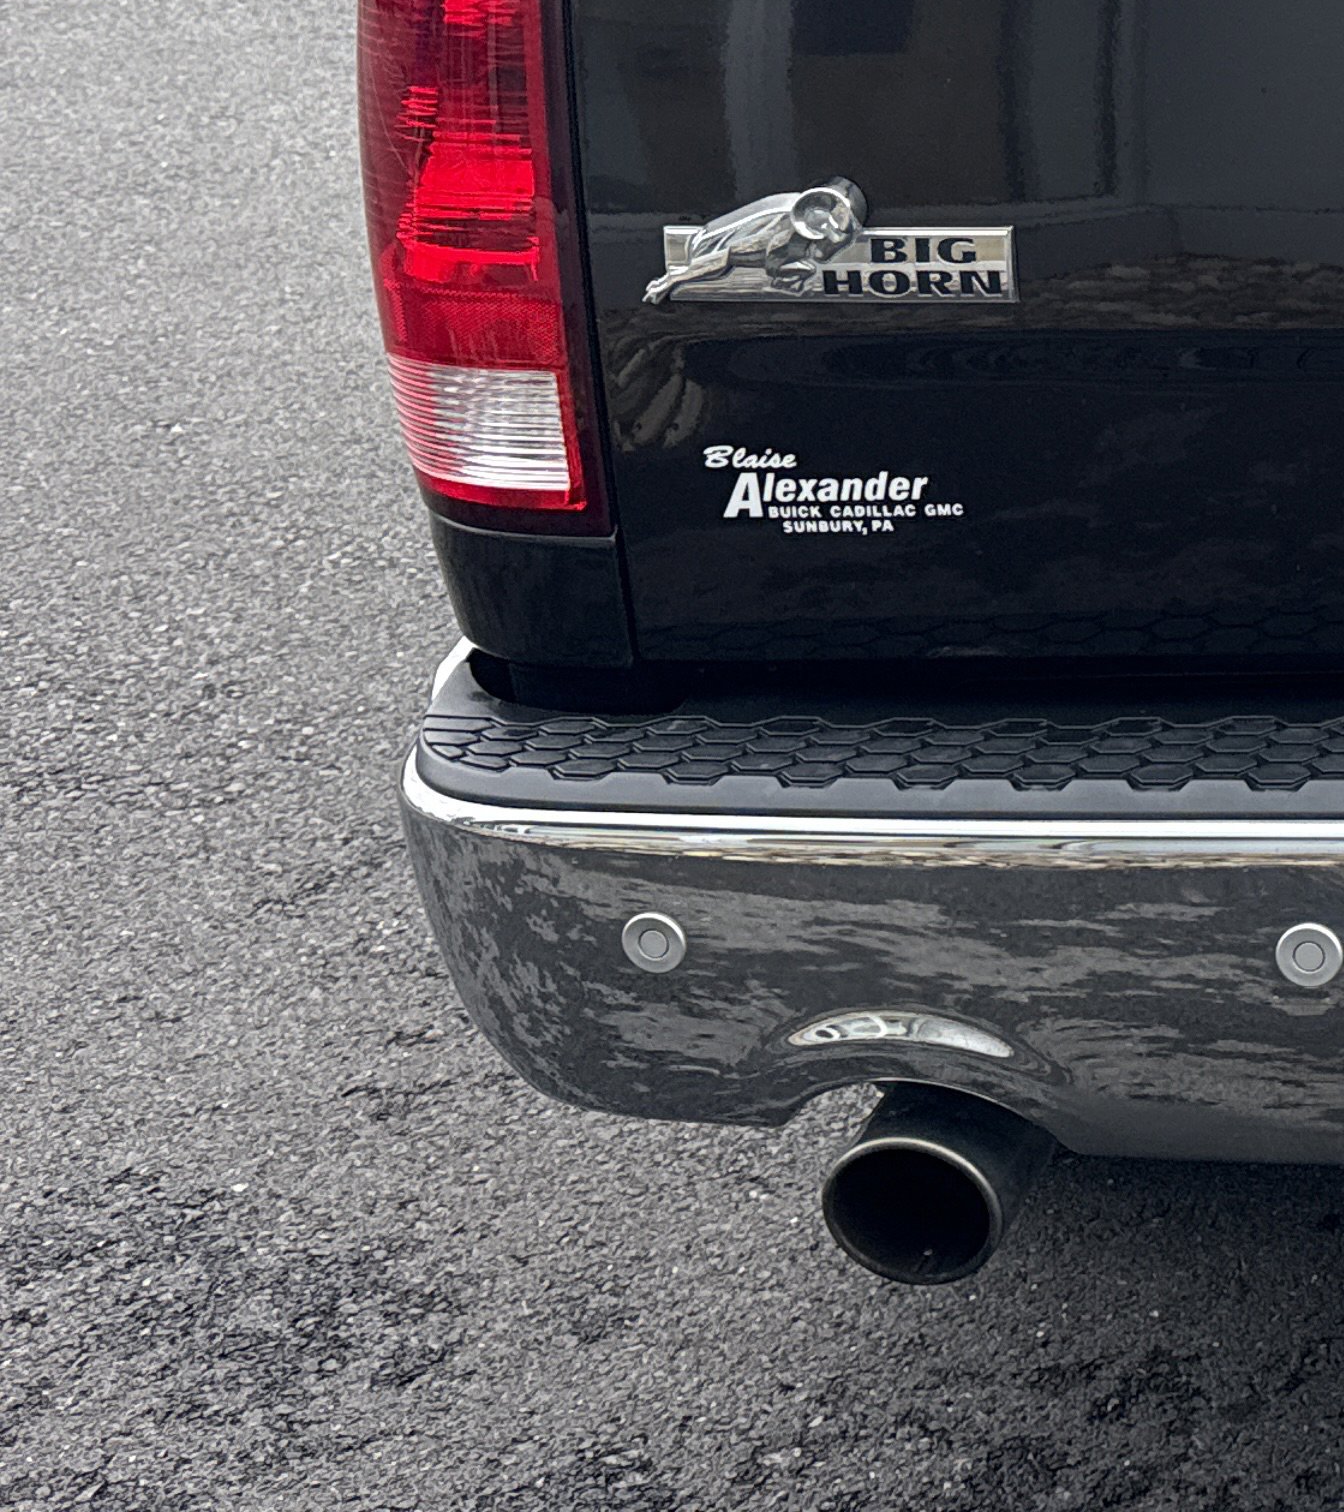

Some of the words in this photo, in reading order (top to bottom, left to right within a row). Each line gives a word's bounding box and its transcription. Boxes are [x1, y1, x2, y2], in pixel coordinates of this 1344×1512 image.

[869, 237, 977, 264] BIG
[822, 269, 1002, 296] HORN
[703, 445, 798, 469] Blaise
[723, 470, 929, 518] Alexander
[768, 505, 822, 519] BUICK
[829, 504, 917, 518] CADILLAC
[924, 503, 964, 517] GMC
[783, 520, 868, 536] SUNBURY,
[871, 520, 895, 533] PA
